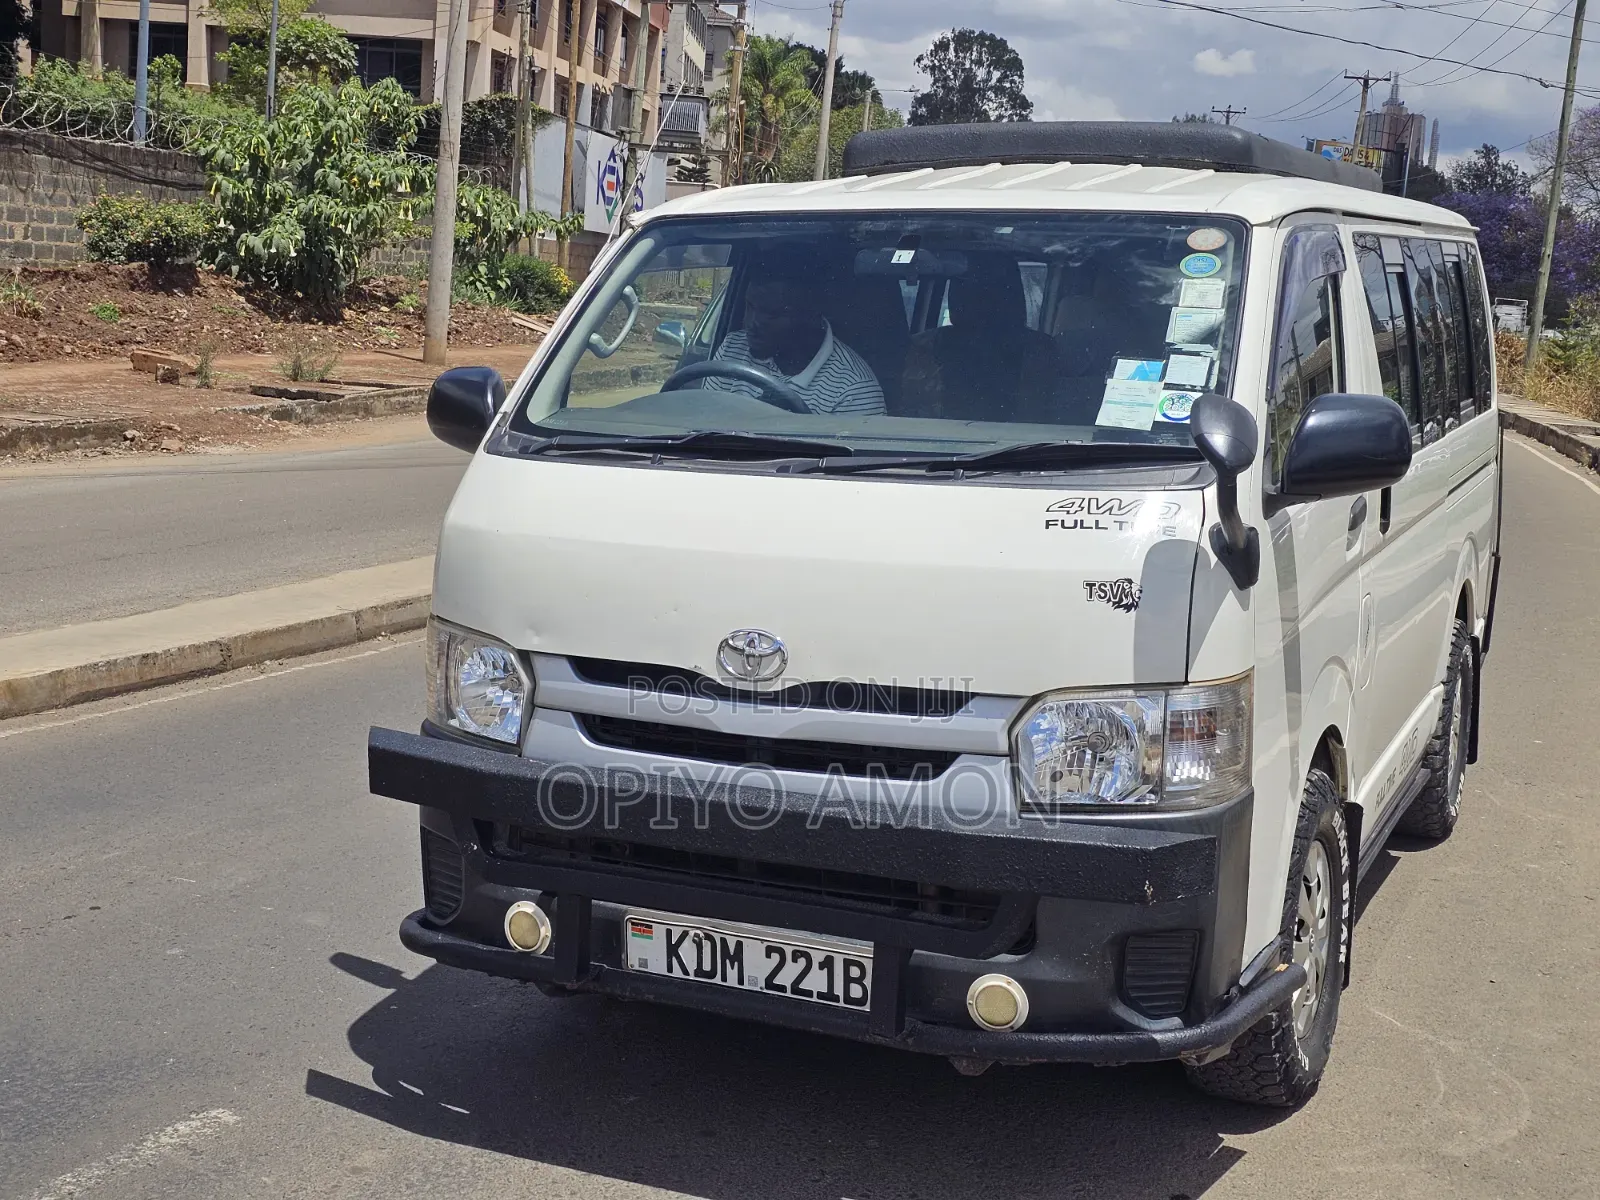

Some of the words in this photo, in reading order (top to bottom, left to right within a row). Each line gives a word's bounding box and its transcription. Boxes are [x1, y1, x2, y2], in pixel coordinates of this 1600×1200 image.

[1343, 147, 1364, 159] DAIS
[1044, 519, 1109, 530] FULL
[1112, 519, 1177, 538] TE
[1331, 810, 1350, 876] BLACK
[1338, 879, 1350, 963] BEAR
[665, 927, 745, 986] KDM
[764, 944, 869, 1007] 221B
